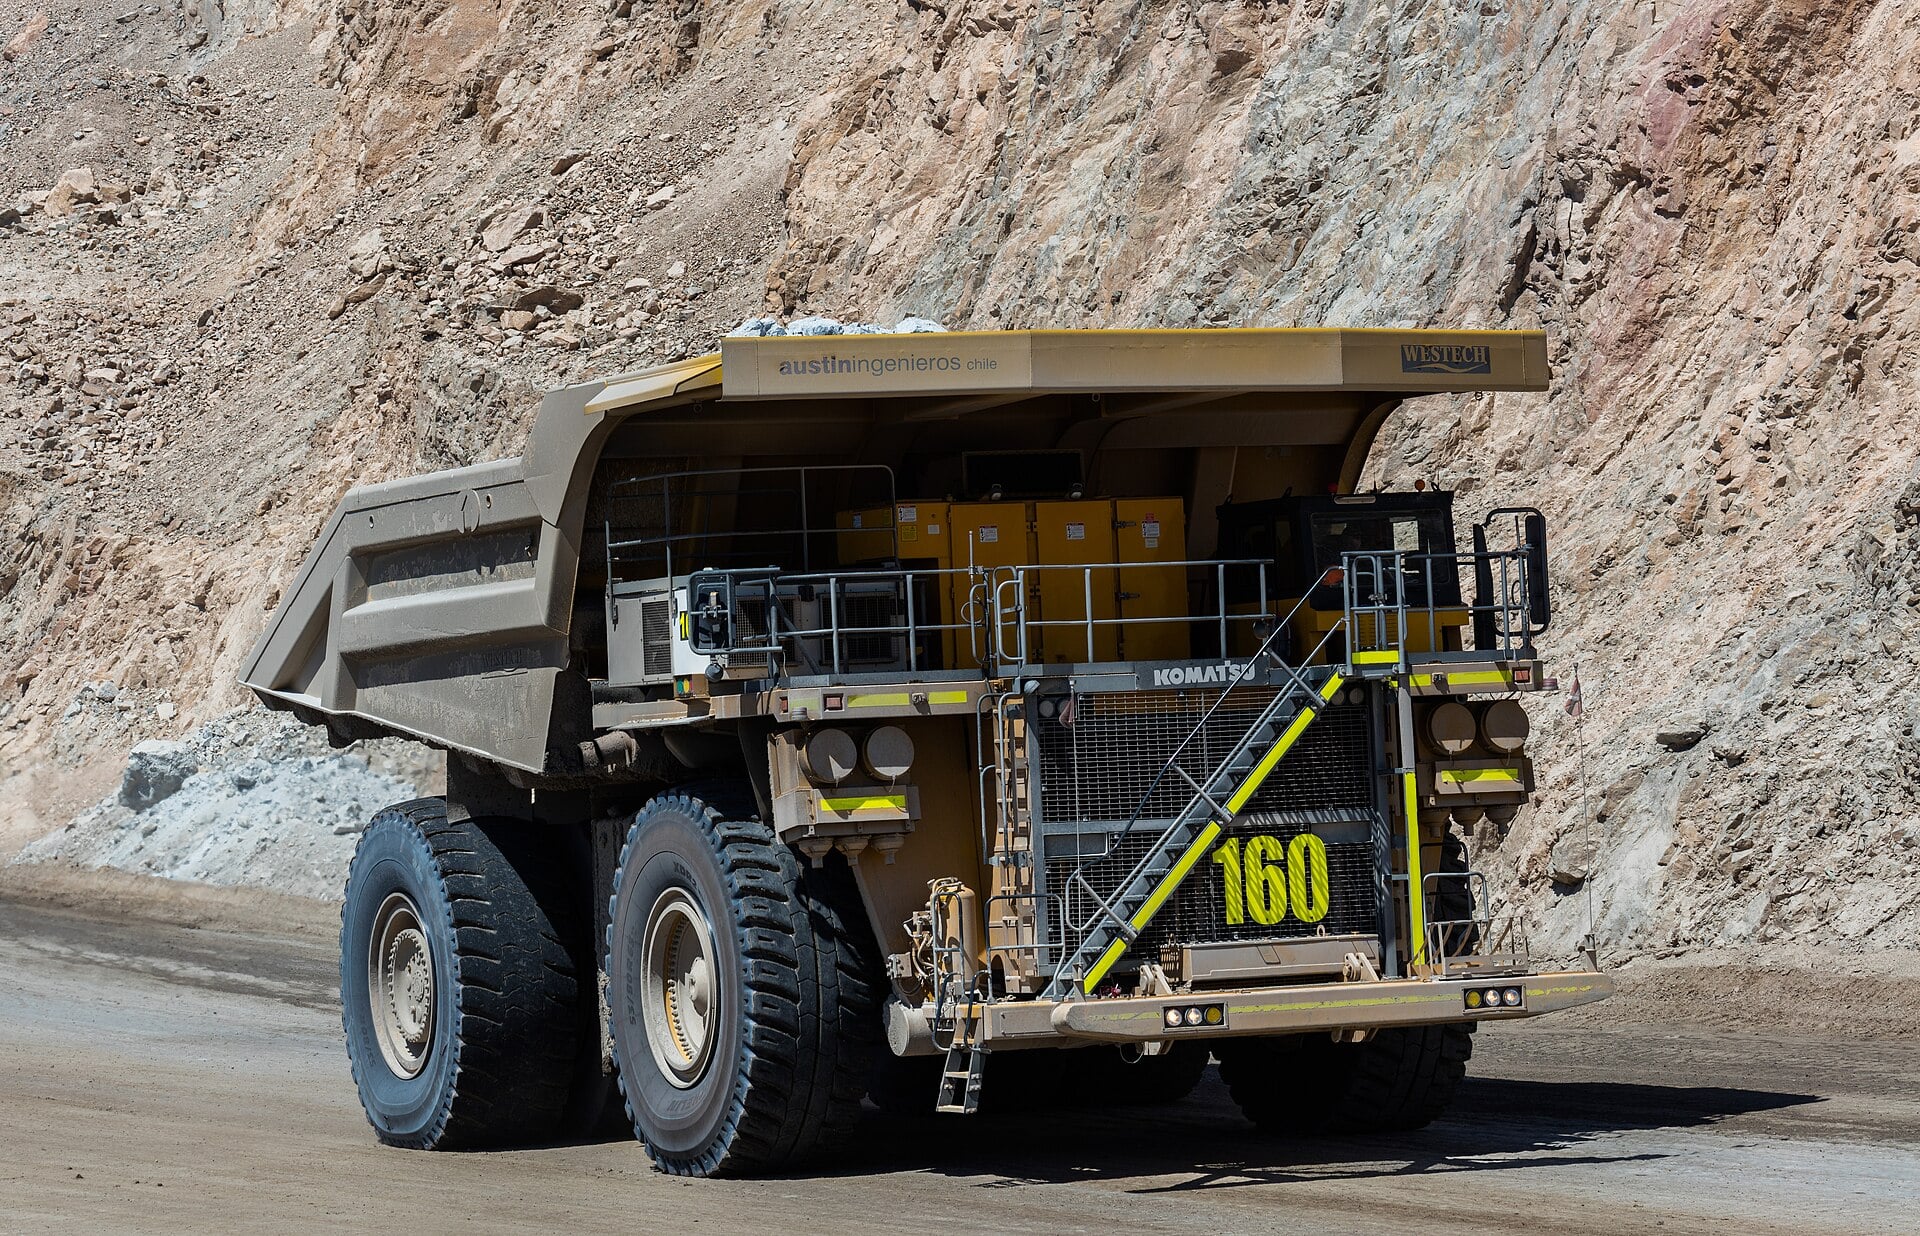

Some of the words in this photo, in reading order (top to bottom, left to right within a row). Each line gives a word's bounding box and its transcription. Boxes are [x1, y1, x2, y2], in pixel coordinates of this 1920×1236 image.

[966, 358, 998, 371] chile
[1403, 346, 1485, 364] WESTECH
[1153, 660, 1256, 687] KOMATSU
[1212, 833, 1330, 926] 160
